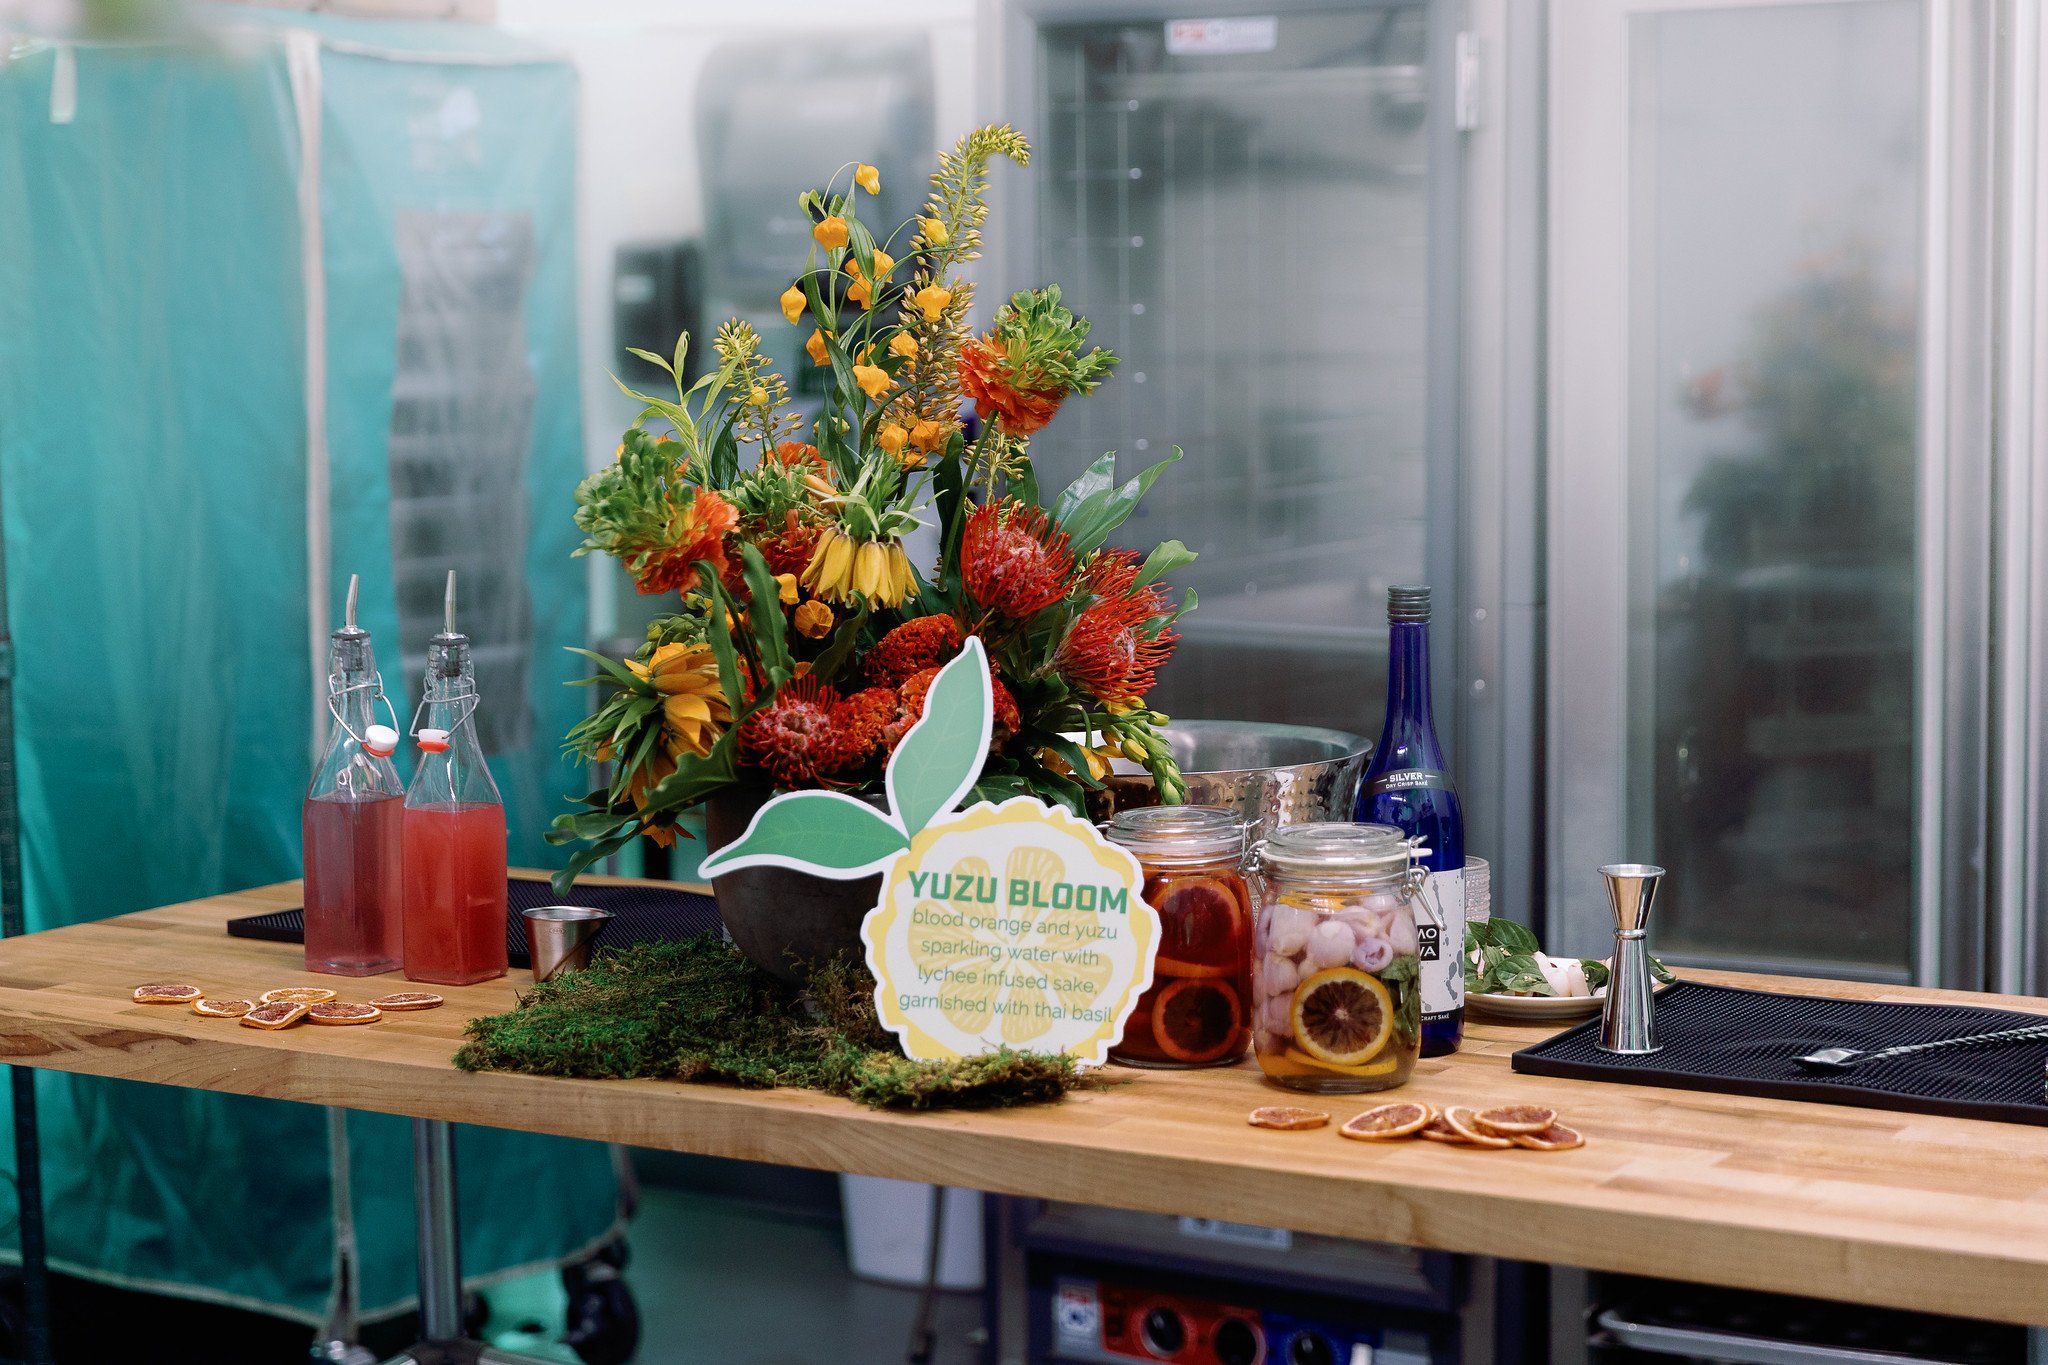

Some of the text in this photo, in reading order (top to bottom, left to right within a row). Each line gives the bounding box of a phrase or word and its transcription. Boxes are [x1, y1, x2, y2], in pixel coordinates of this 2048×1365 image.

[1389, 772, 1423, 782] SILVER
[908, 870, 1128, 914] YUZU BLOOM
[913, 908, 1117, 941] blood orange and yuzu
[921, 939, 1099, 965] sparkling water with
[918, 964, 1098, 995] lychee infused sake,
[899, 993, 1113, 1023] garnished with thai basil
